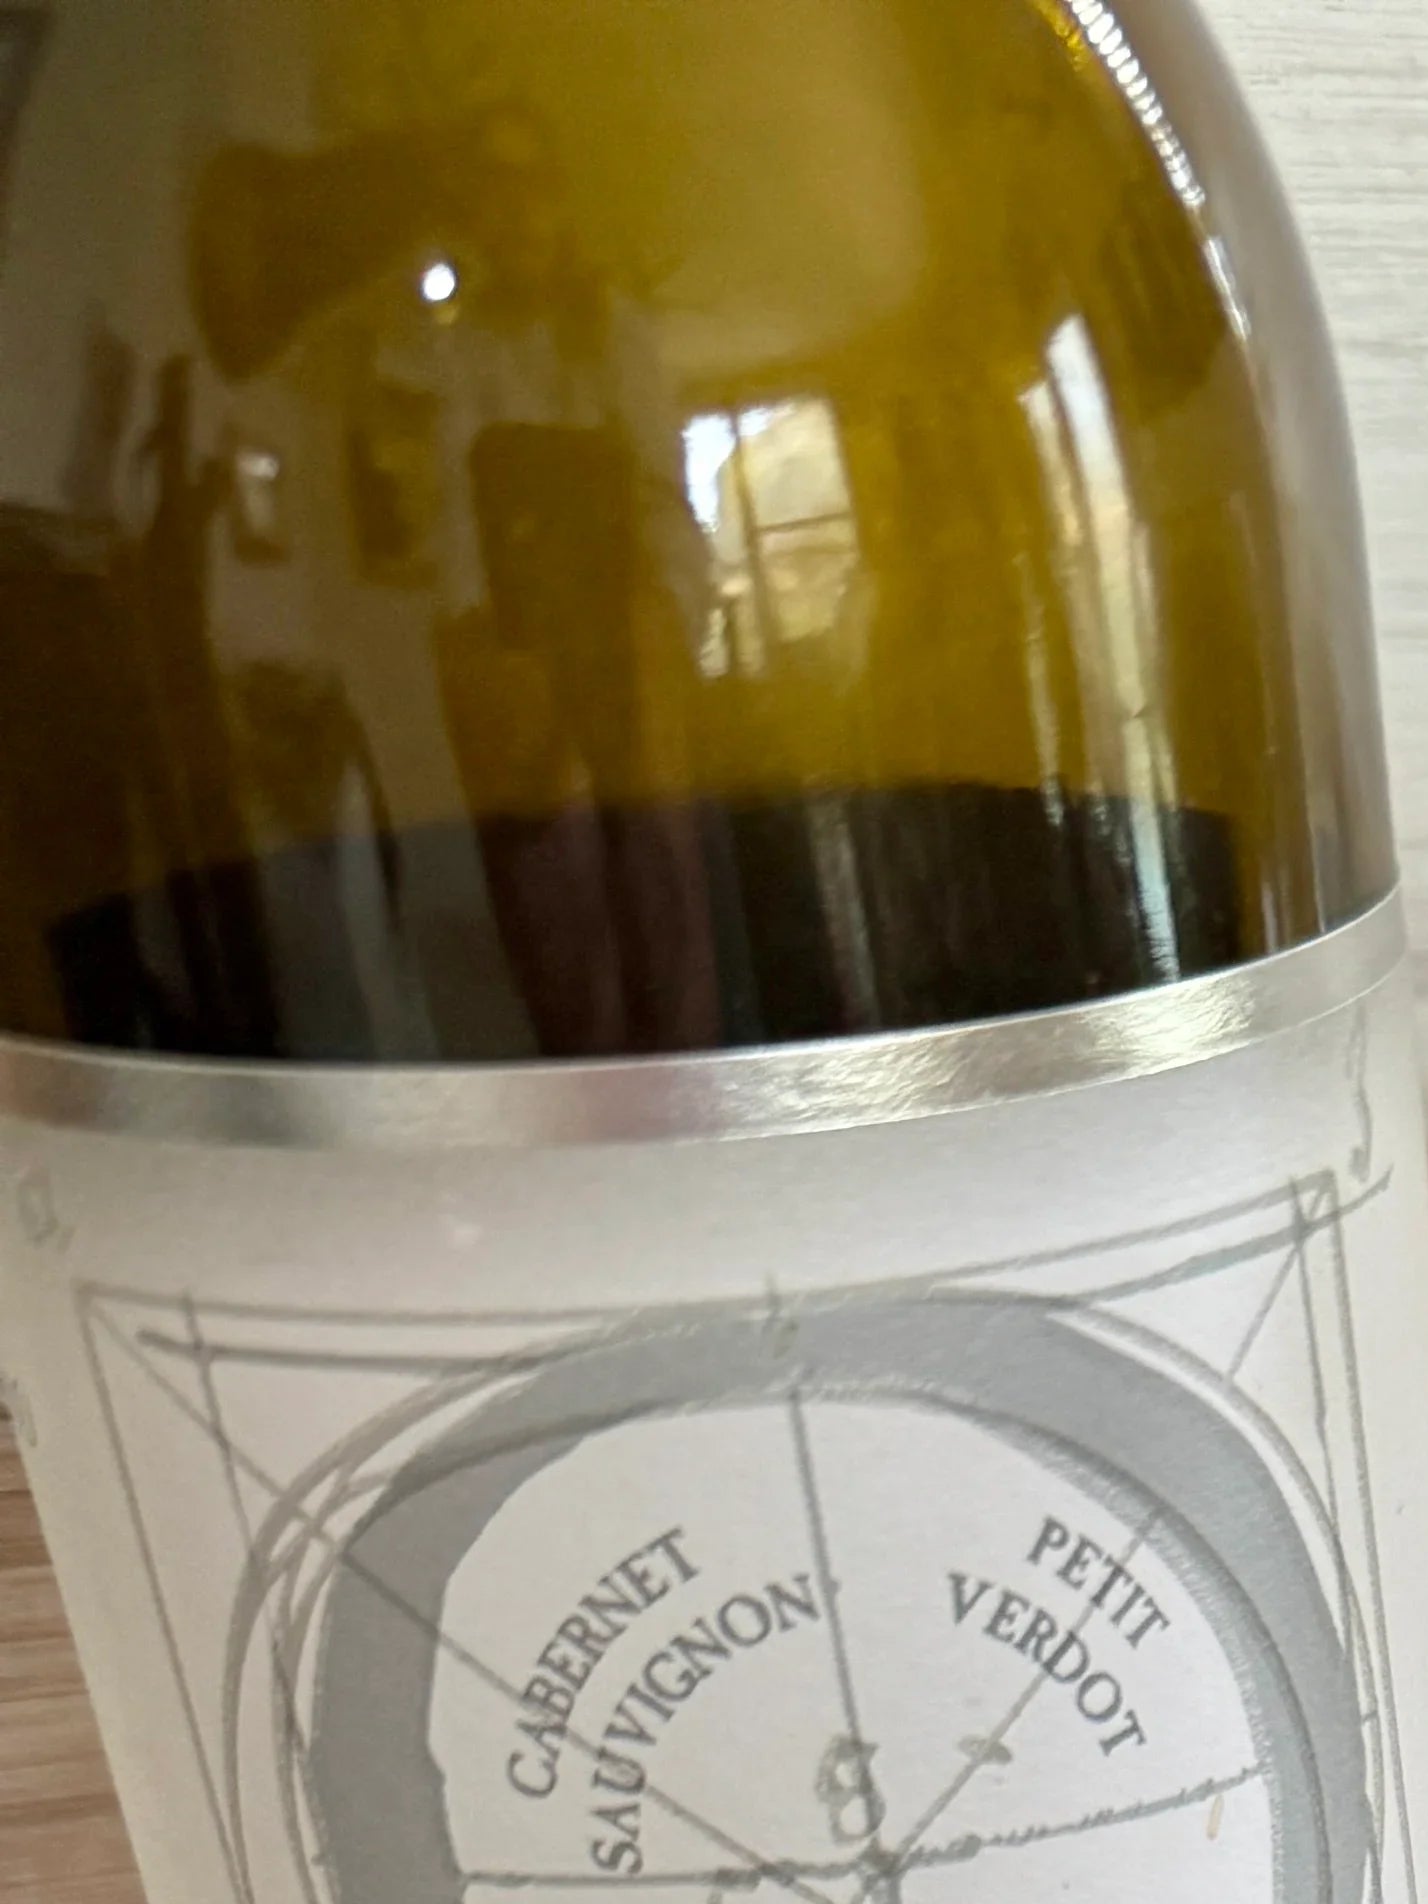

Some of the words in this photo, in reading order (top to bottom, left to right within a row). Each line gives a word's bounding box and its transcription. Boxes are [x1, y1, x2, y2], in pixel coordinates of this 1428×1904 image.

[506, 1527, 703, 1800] CABERNET
[946, 1569, 1149, 1759] VERDOT
[1025, 1515, 1171, 1651] PETIT
[590, 1571, 822, 1876] SAUVIGNON
